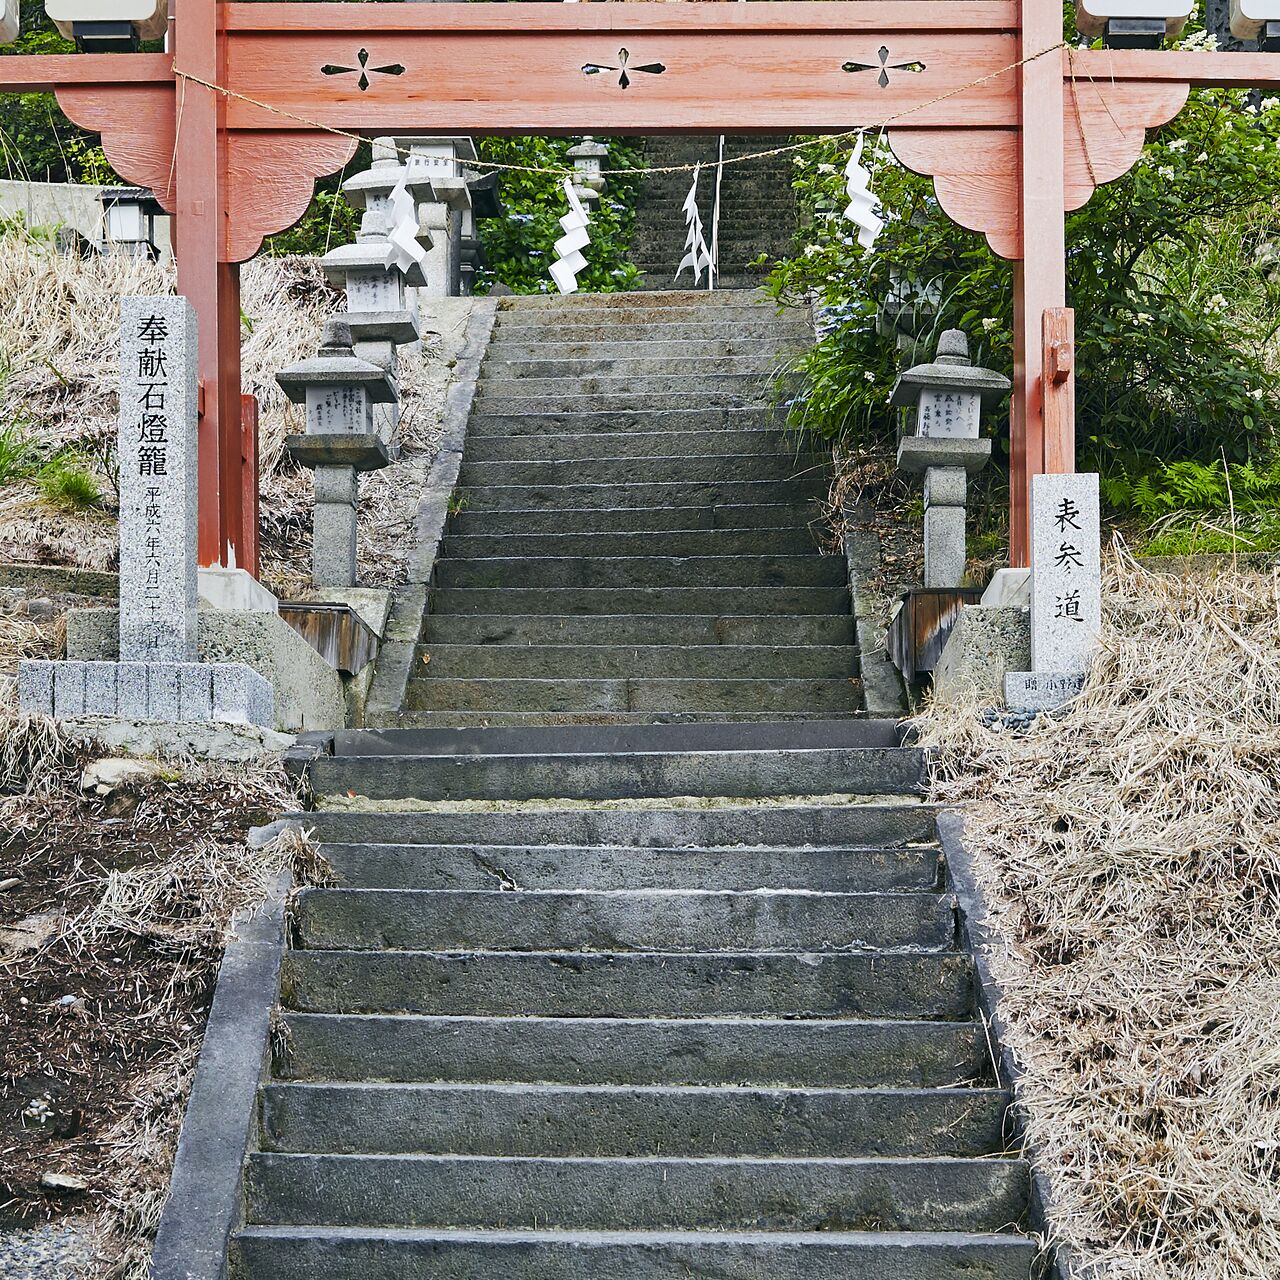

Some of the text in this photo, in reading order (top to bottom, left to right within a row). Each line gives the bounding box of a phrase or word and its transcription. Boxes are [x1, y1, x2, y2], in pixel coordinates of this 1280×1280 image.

[137, 315, 169, 477] 奉献石燈籠
[1053, 497, 1084, 623] 表参道
